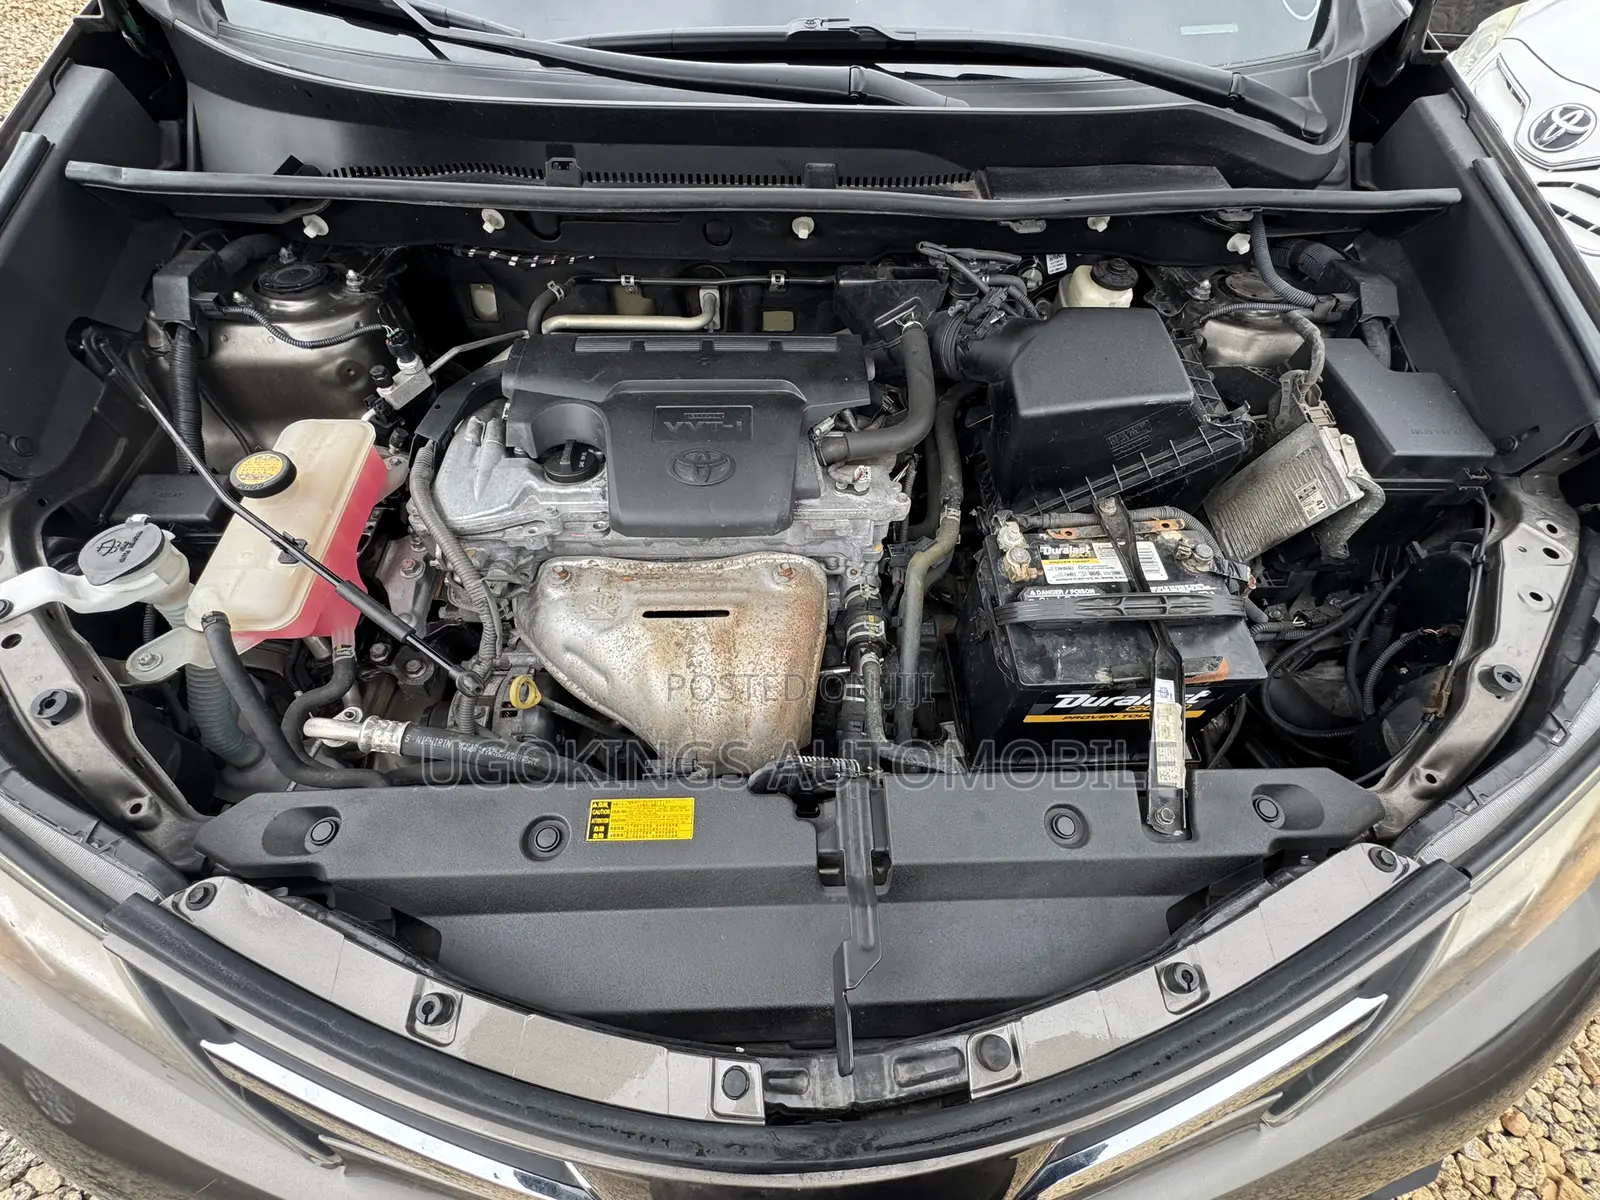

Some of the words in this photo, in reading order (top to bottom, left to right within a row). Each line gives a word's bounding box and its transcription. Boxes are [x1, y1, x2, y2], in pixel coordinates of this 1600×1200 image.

[1040, 546, 1091, 555] Duralast
[1035, 588, 1064, 596] DANGER
[414, 735, 453, 749] NICHIRIN
